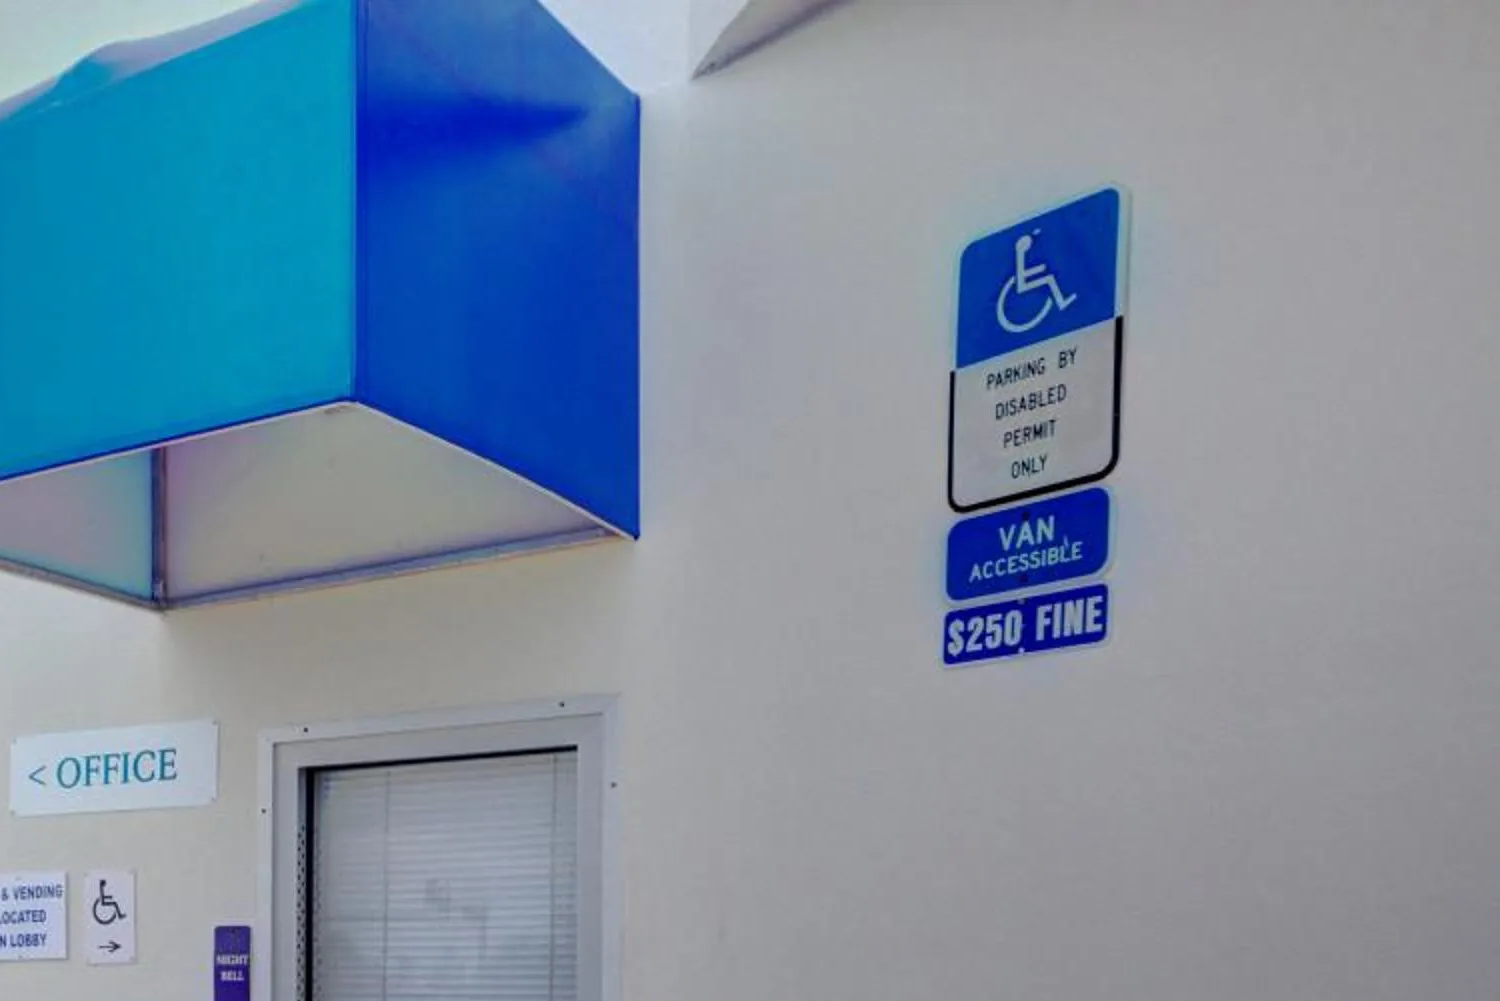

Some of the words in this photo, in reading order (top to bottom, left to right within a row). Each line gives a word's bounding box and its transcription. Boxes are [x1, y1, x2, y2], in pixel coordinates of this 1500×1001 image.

[986, 357, 1045, 390] PARKING
[1058, 348, 1079, 369] BY
[995, 383, 1067, 421] DISABLED
[1003, 419, 1057, 449] PERMIT
[1010, 455, 1048, 480] ONLY
[998, 514, 1056, 551] VAN
[968, 540, 1084, 584] ACCESSIBLE
[947, 608, 1023, 657] $250
[1035, 595, 1104, 641] FINE
[56, 747, 178, 789] OFFICE
[1, 887, 9, 901] &
[13, 883, 64, 901] VENDING
[9, 933, 48, 947] LOBBY
[216, 954, 249, 966] NIGHT
[220, 970, 245, 982] BELL
